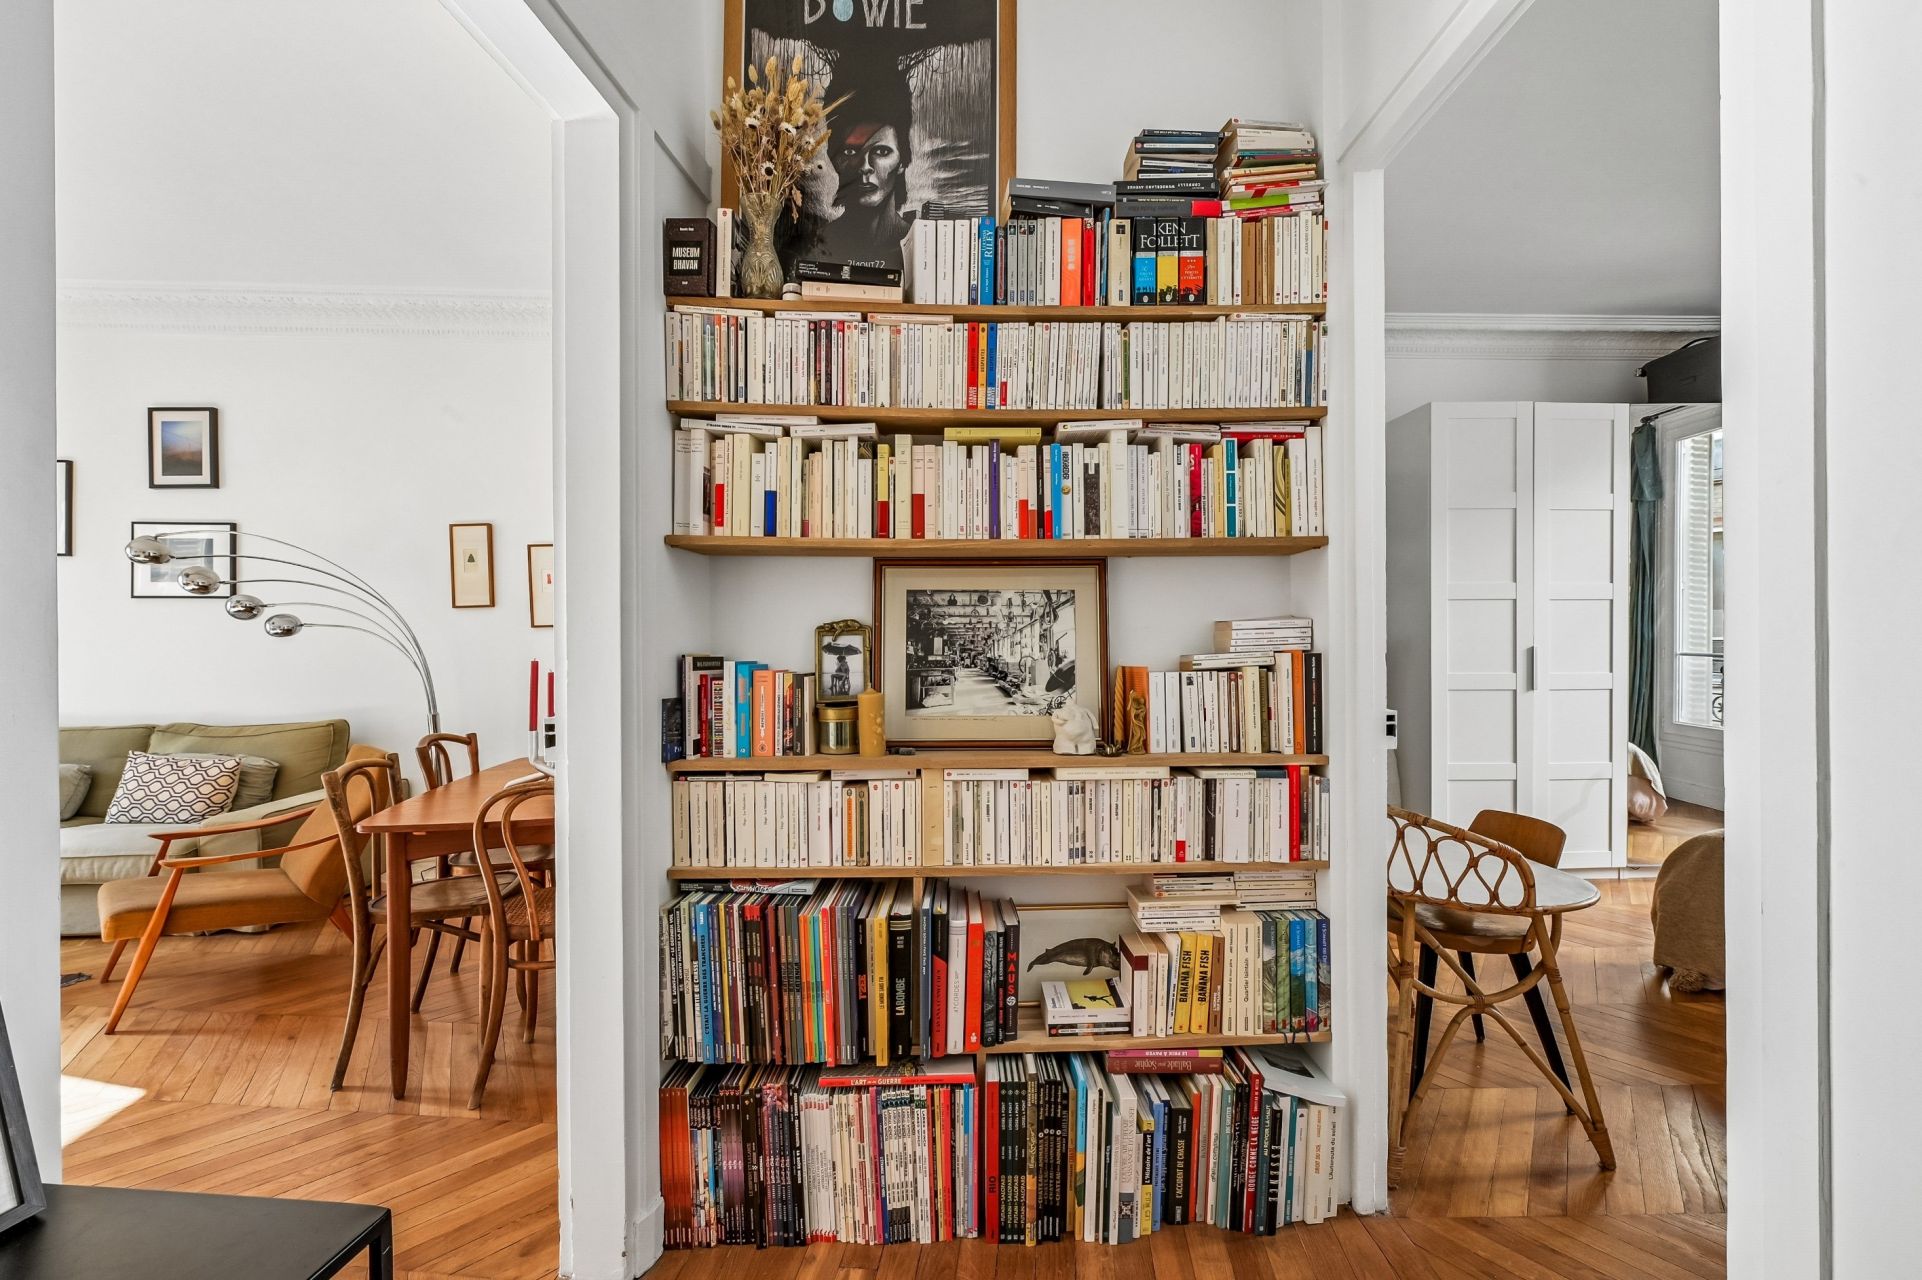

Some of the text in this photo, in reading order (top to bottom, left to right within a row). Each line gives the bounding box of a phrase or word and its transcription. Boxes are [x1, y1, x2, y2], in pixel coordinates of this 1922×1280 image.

[1140, 234, 1200, 249] FOLLETT
[1153, 221, 1187, 236] KEN
[672, 247, 700, 258] MUSEUM
[984, 230, 993, 258] RILEY
[673, 259, 699, 270] BHAVAN
[793, 962, 802, 993] KATANGA
[1007, 951, 1017, 995] MAUS
[1179, 950, 1192, 1003] BANANA FISH
[1197, 950, 1210, 1003] BANANA FISH
[703, 1004, 710, 1013] LA
[1135, 1059, 1157, 1072] Sophie
[1167, 1060, 1192, 1071] Ballade
[1145, 1148, 1152, 1156] de
[1247, 1116, 1259, 1192] ROUGE COMME LA NEIGE
[1263, 1148, 1269, 1156] AU
[1330, 1137, 1337, 1146] du
[1121, 1155, 1129, 1184] LOUVRE
[1127, 1148, 1135, 1184] NAISSANCE
[1144, 1156, 1152, 1184] L'Histoire
[1175, 1139, 1185, 1198] L'ACCIDENT DE CHASSE
[1268, 1145, 1281, 1202] ESSENCE
[1328, 1147, 1336, 1180] L'Autoroute
[988, 1175, 997, 1194] RIO
